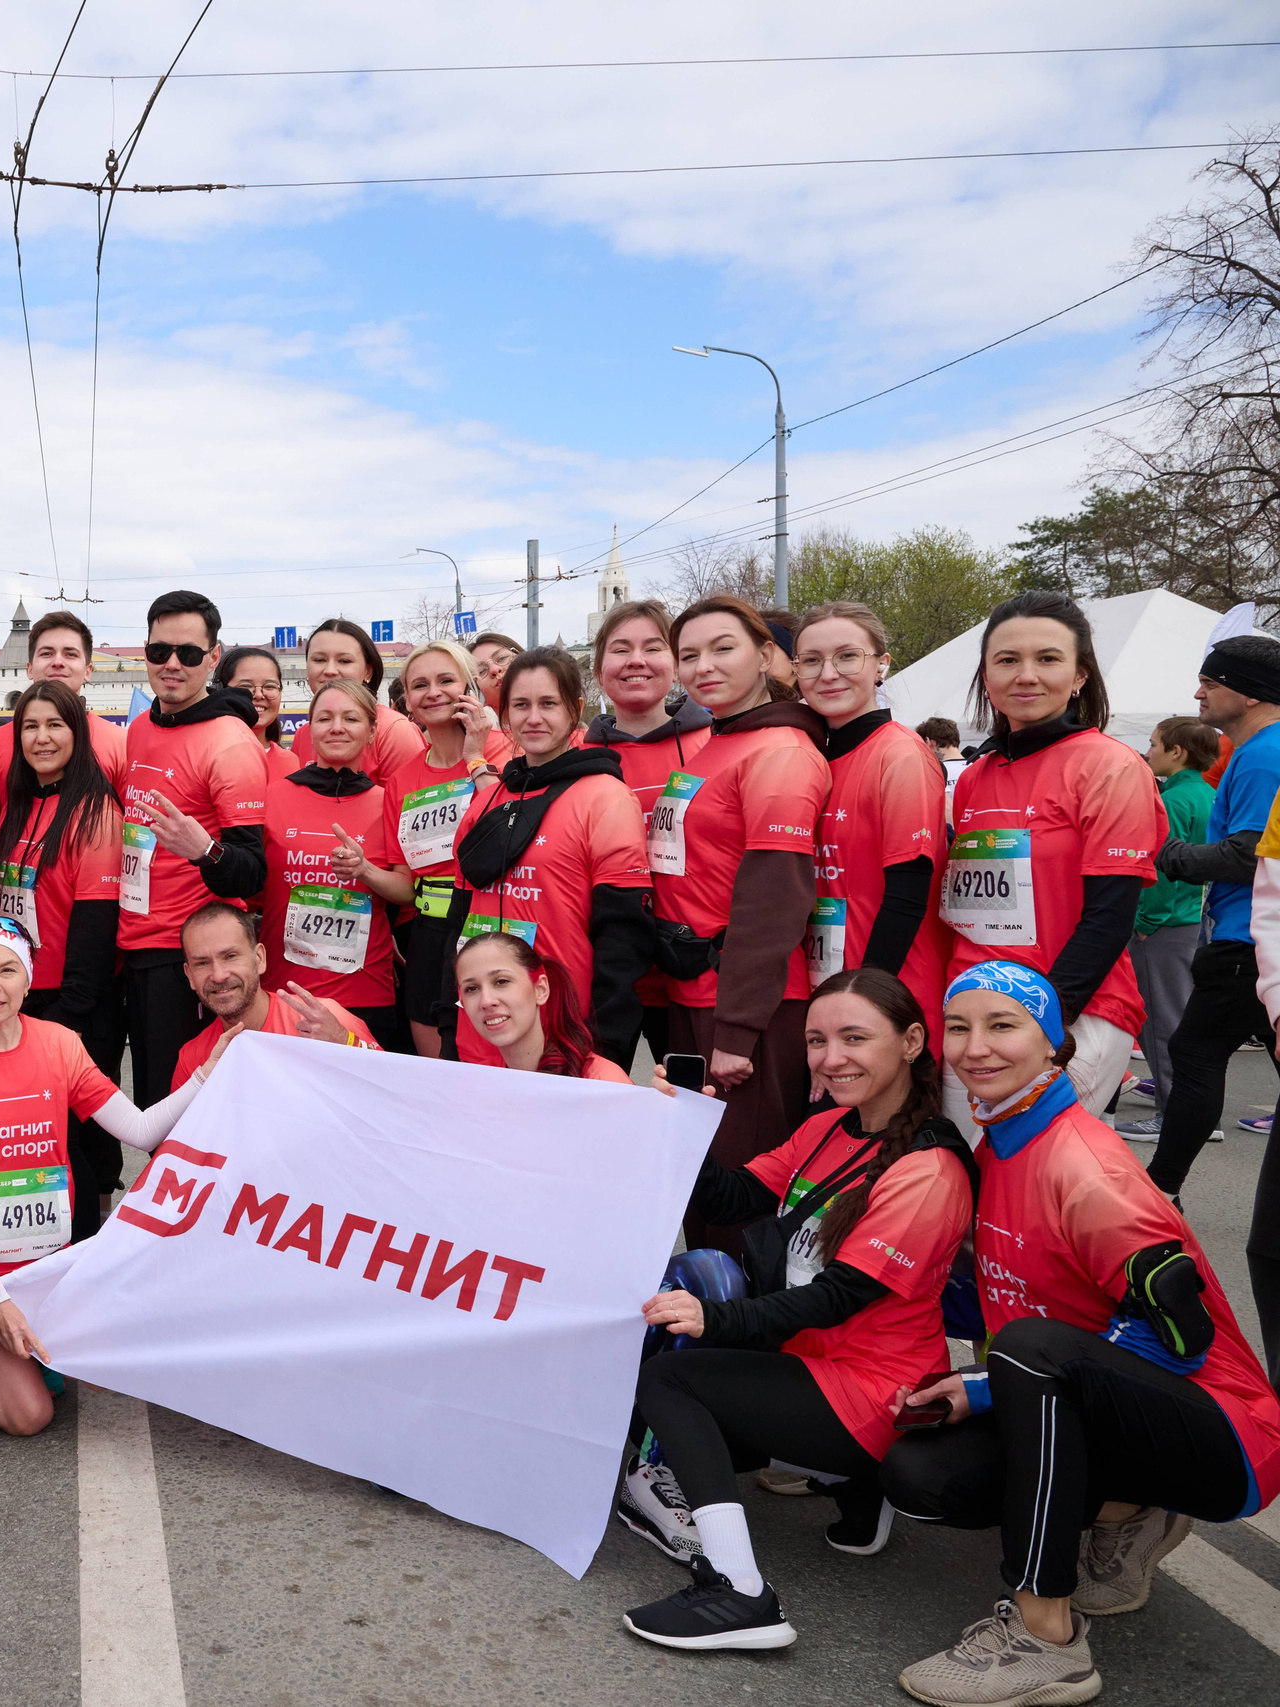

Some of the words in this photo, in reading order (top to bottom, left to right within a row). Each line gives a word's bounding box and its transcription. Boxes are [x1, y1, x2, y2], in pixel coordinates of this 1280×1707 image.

[411, 803, 457, 831] 49193
[768, 824, 812, 837] ЯГОДЫ
[1107, 848, 1151, 859] ЯГОД
[283, 871, 302, 884] за
[953, 870, 1010, 898] 49206
[301, 913, 356, 939] 49217
[298, 950, 319, 958] МАГНИТ
[1, 1139, 58, 1158] спорт
[2, 1201, 57, 1229] 49184
[0, 1247, 23, 1255] МАГНИТ
[223, 1182, 546, 1322] МАГНИТ
[868, 1237, 916, 1269] ЯГОДЫ
